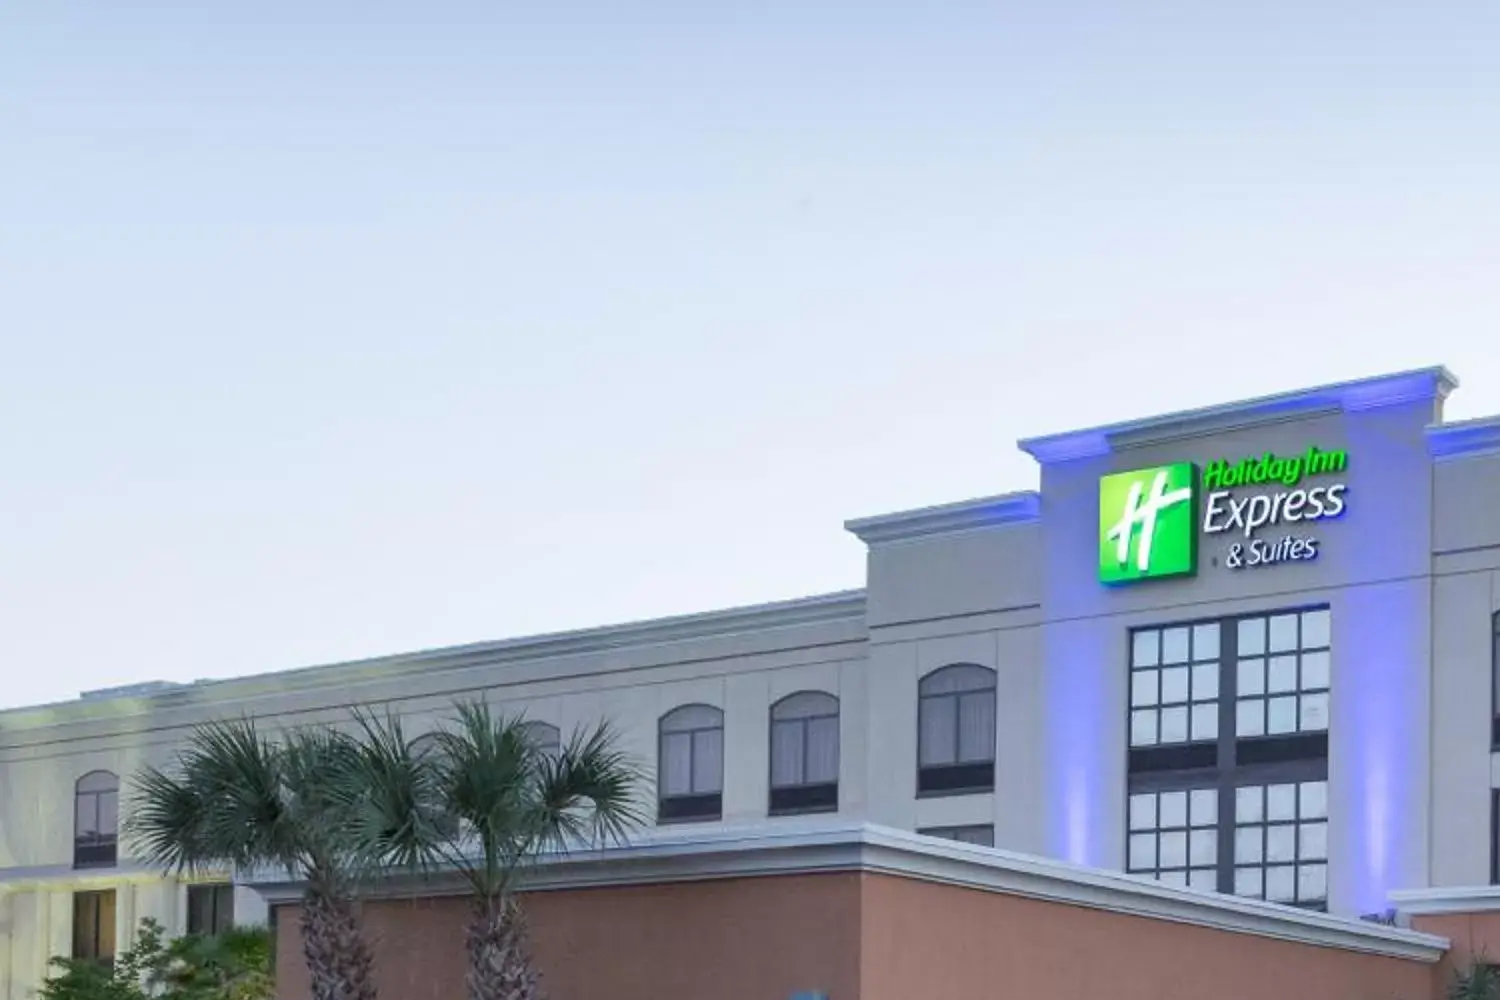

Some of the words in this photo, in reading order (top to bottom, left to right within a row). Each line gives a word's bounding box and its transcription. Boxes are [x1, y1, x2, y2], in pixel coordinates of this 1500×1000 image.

[1203, 452, 1302, 489] Holiday
[1304, 447, 1346, 476] Inn
[1203, 484, 1345, 538] Express
[1225, 543, 1243, 569] &
[1246, 535, 1317, 565] Suites
